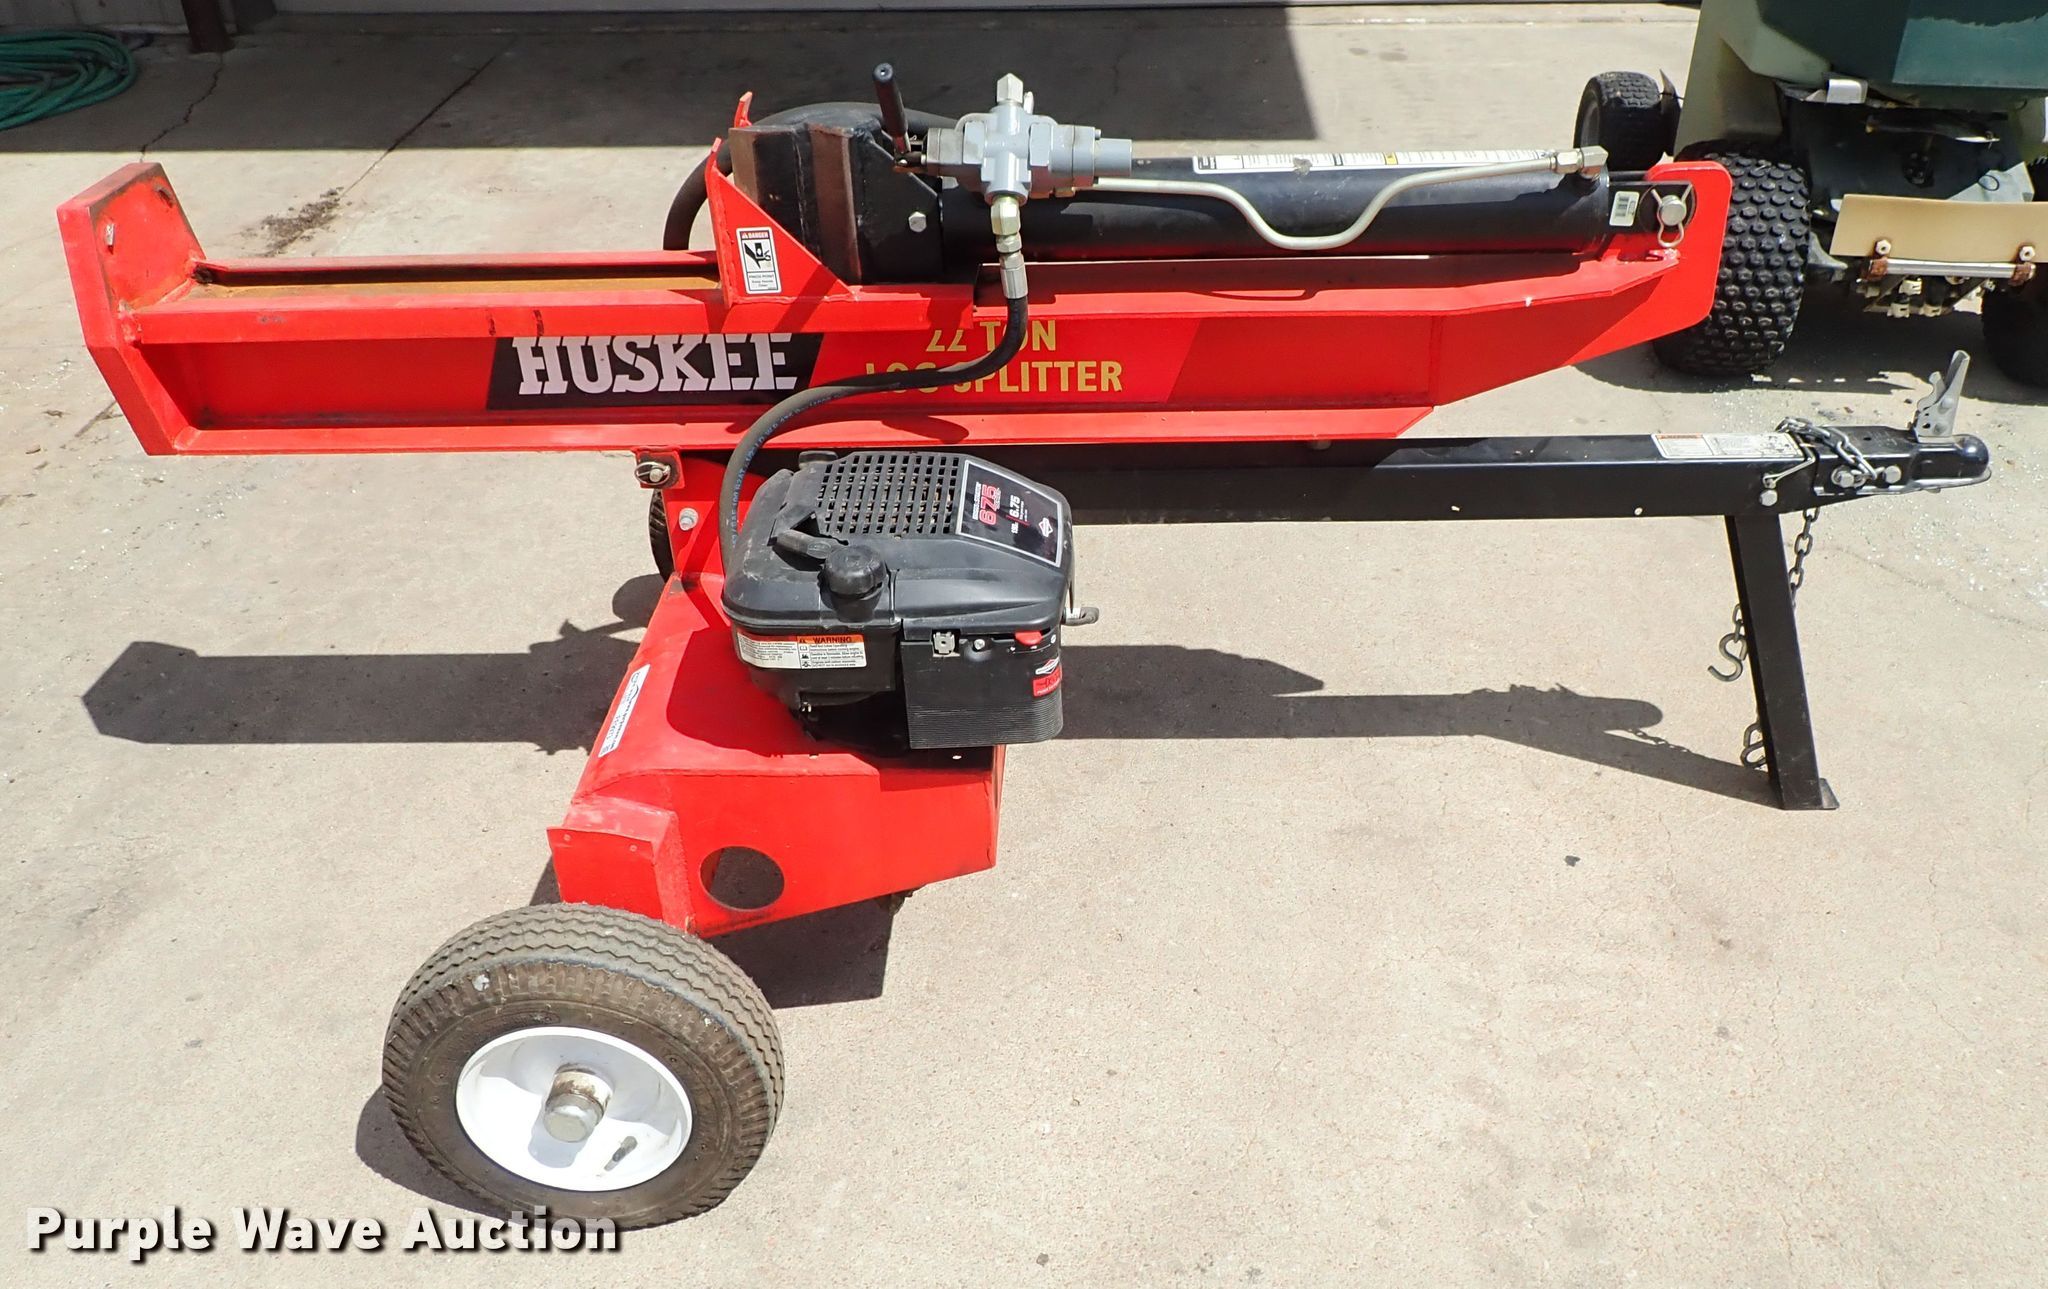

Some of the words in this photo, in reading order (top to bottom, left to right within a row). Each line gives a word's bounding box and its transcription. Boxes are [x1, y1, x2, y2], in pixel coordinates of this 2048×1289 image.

[512, 333, 798, 395] HUSKEE
[979, 484, 998, 526] 675
[1009, 494, 1021, 518] 6.75
[813, 636, 852, 644] WARNING
